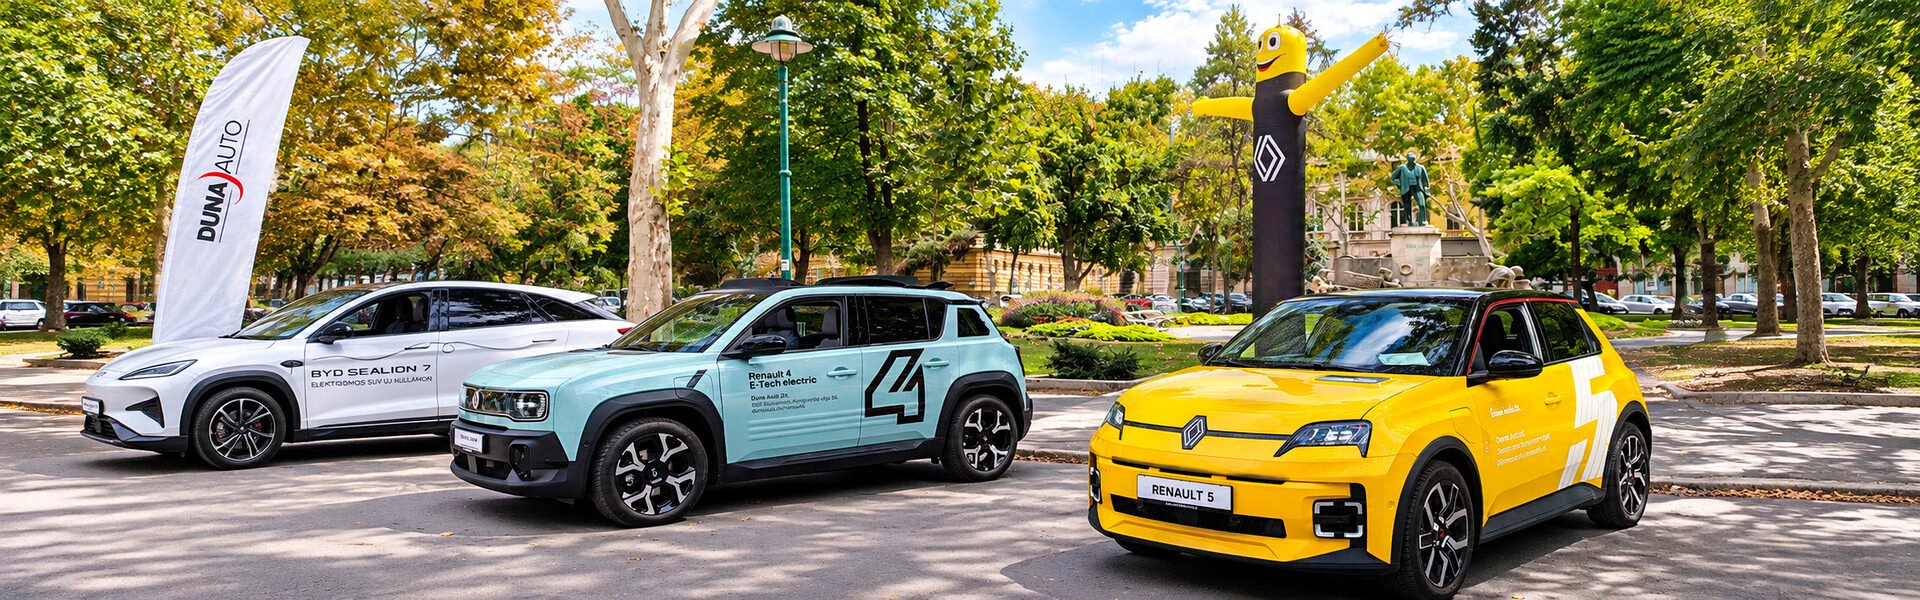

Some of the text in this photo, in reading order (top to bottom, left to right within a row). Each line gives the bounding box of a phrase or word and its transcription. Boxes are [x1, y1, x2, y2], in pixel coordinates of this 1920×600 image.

[197, 120, 242, 242] DUNA AUTO
[311, 370, 344, 378] BYD
[348, 365, 417, 376] SEALION
[748, 369, 792, 380] Renault 4
[749, 376, 817, 389] E-Tech electric
[1152, 484, 1215, 503] RENAULT 5
